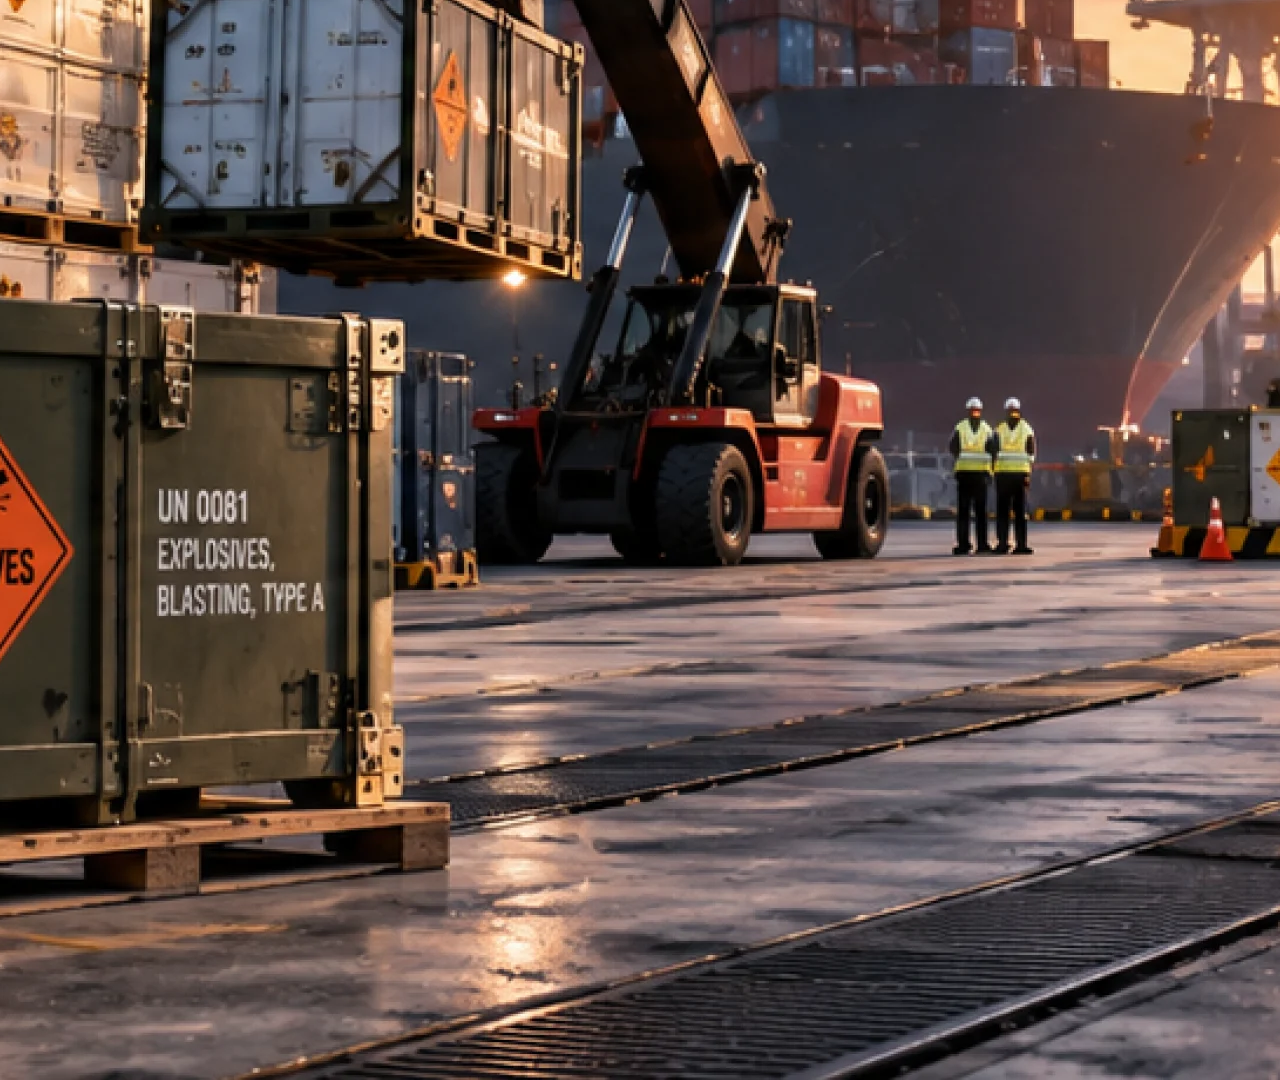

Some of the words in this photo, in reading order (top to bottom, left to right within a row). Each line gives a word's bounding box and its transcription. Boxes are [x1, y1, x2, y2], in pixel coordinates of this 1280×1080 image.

[158, 488, 188, 523] UN
[196, 490, 247, 523] 0081
[158, 537, 275, 572] EXPLOSIVES,
[158, 582, 256, 617] BLASTING,
[261, 582, 308, 612] TYPE
[311, 582, 325, 612] A
